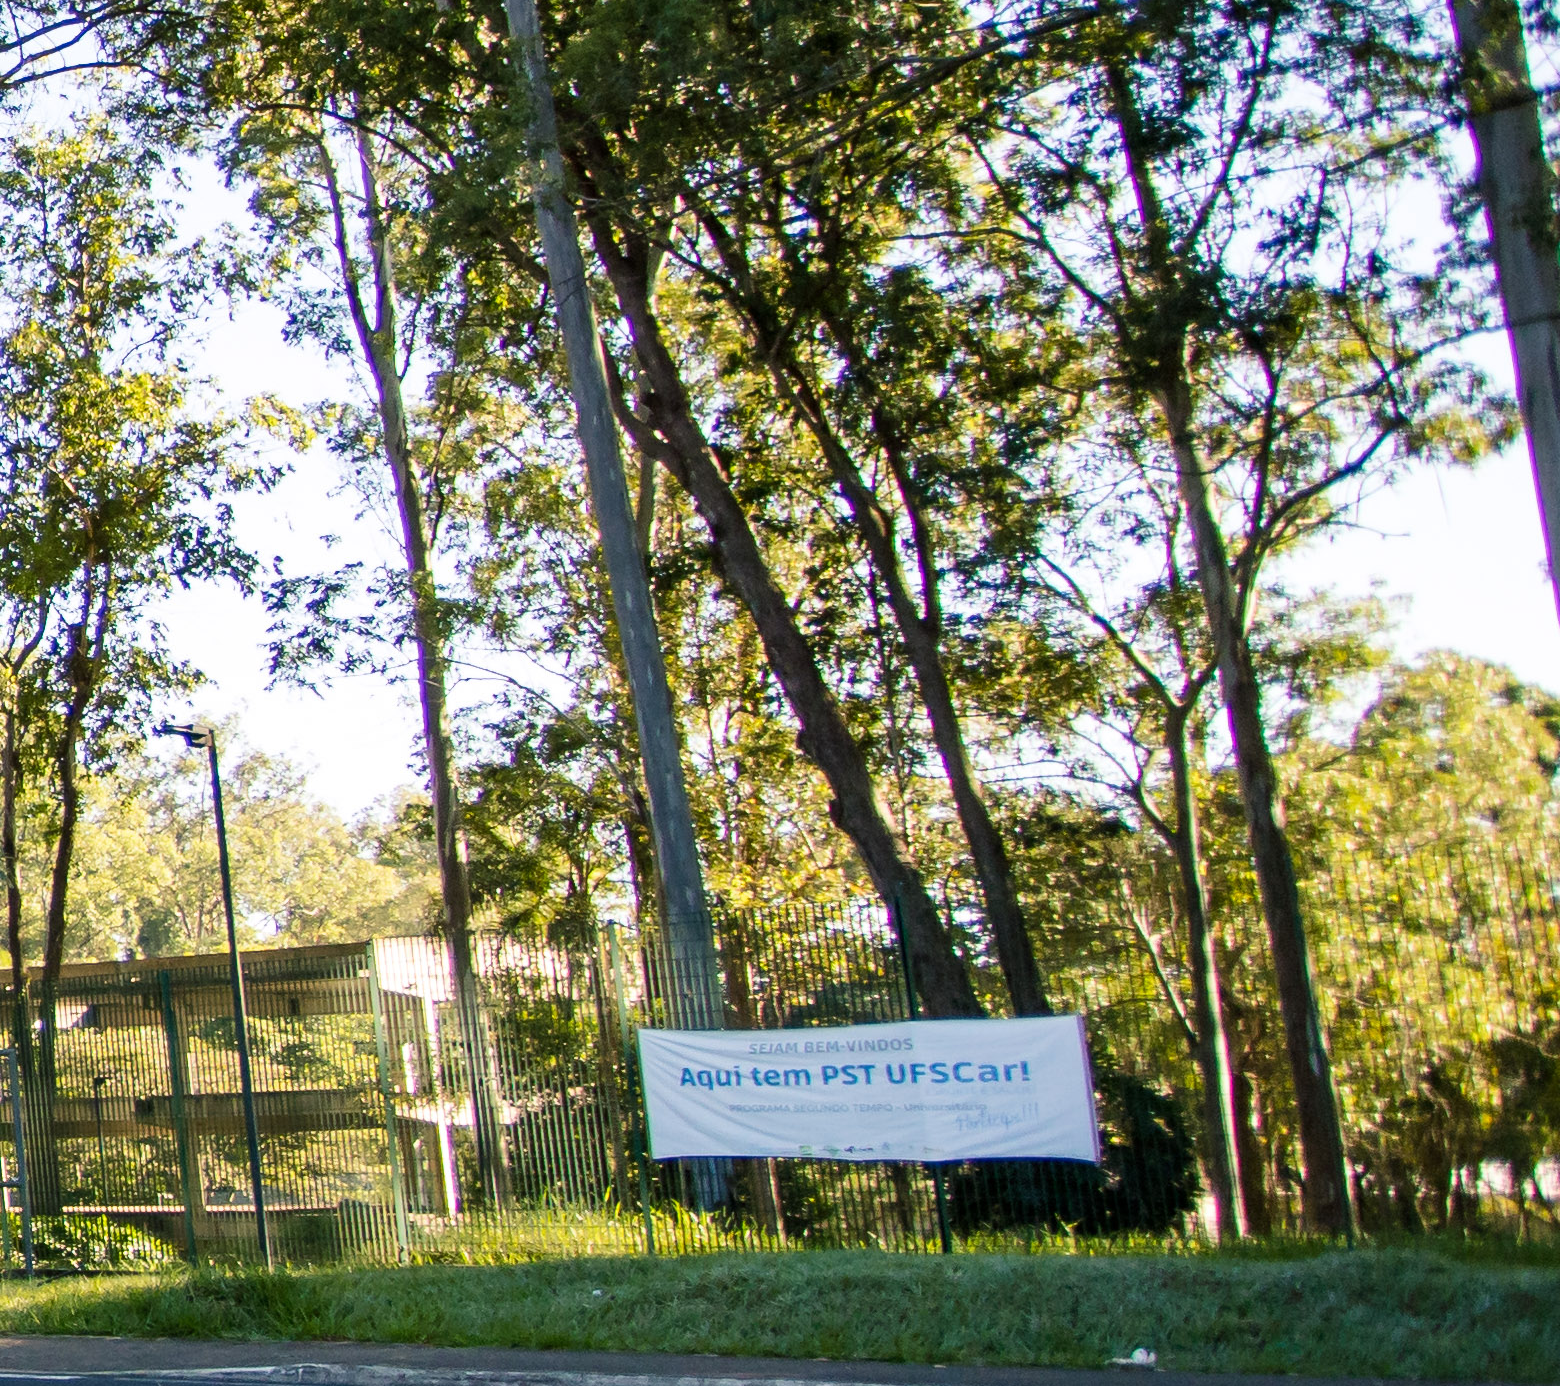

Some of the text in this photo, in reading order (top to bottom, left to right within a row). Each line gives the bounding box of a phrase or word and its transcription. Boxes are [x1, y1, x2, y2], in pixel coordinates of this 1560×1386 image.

[749, 1037, 914, 1054] SEJAM BEM-VINDOS
[680, 1061, 1031, 1090] Aqui tem PST UFSCar!
